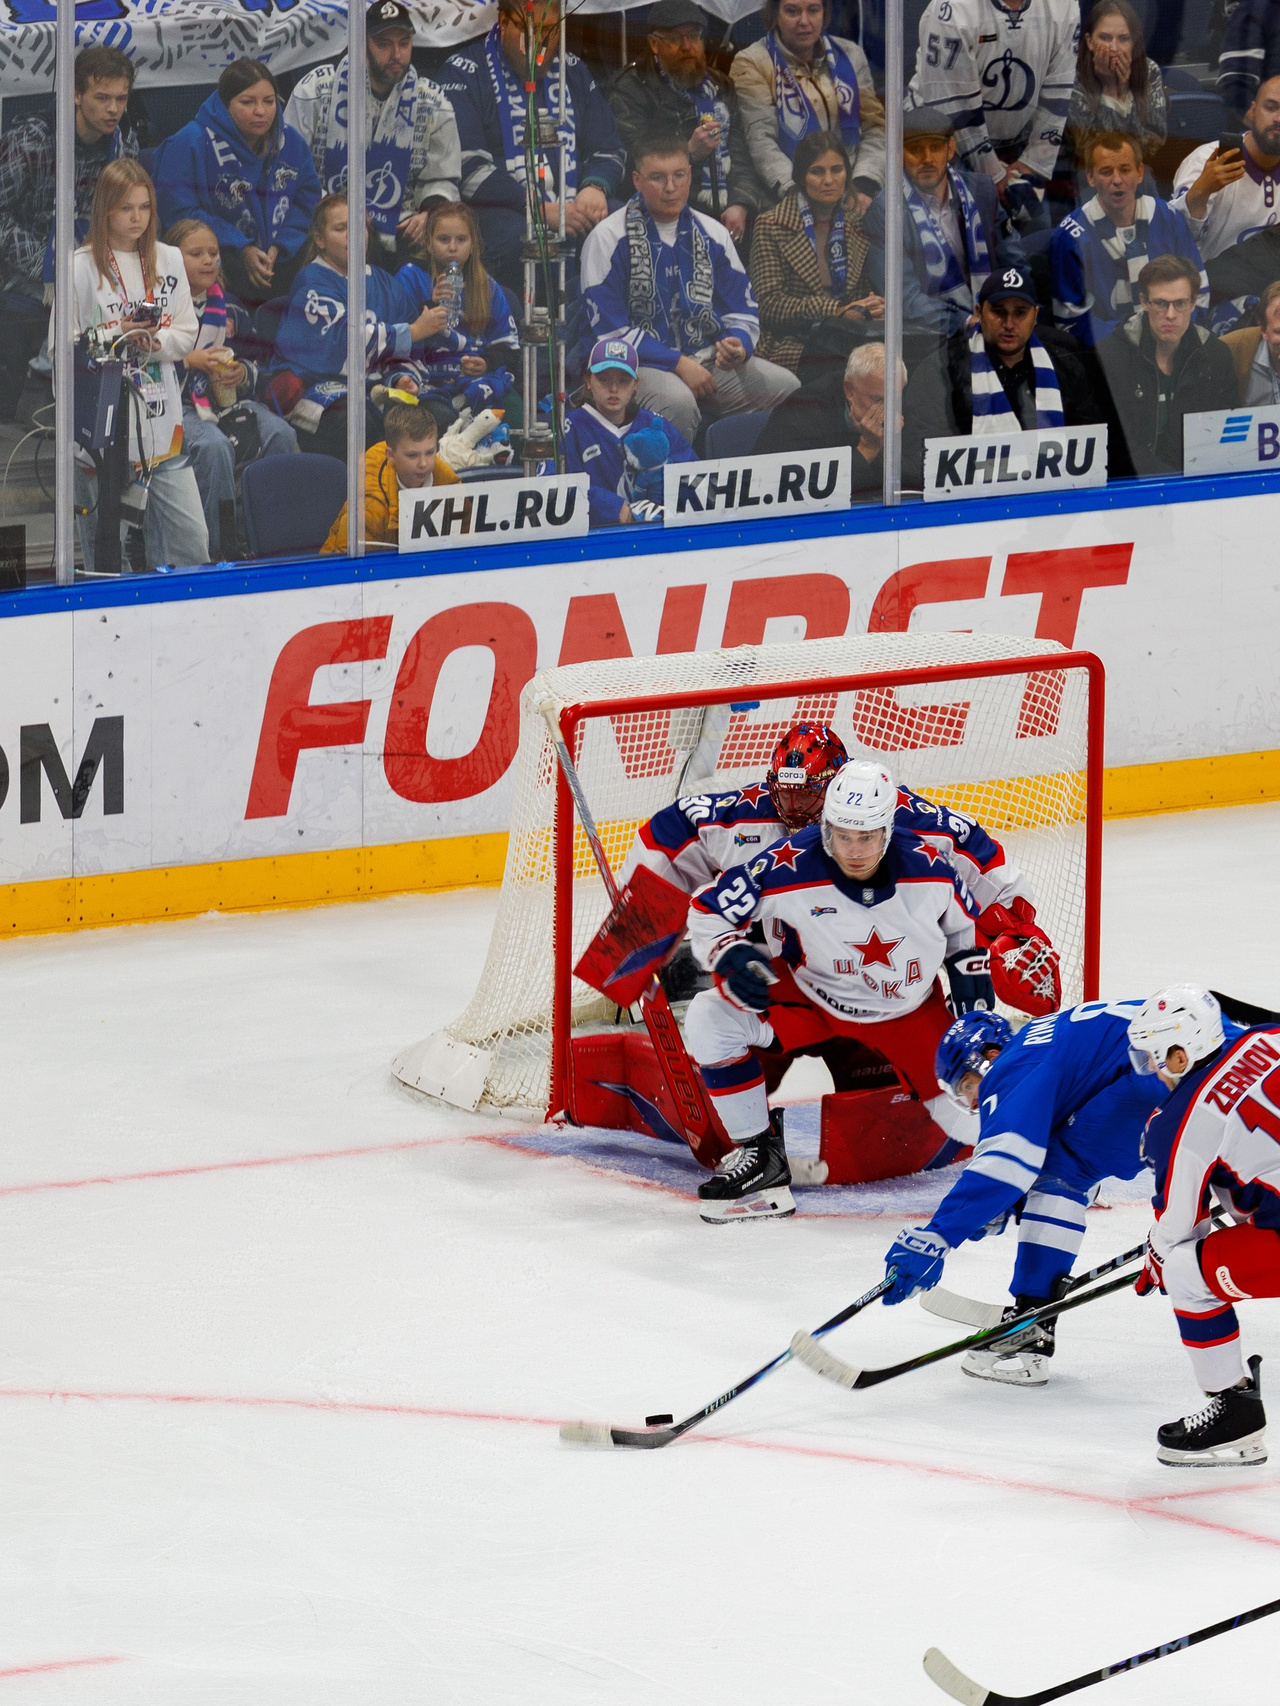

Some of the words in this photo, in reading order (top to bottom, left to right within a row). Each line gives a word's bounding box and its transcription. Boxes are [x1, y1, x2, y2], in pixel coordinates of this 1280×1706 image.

[925, 33, 962, 70] 57
[677, 459, 839, 513] KHL.RU
[935, 437, 1096, 488] KHL.RU
[411, 486, 577, 540] KHL.RU
[244, 542, 1134, 819] FONBET
[0, 715, 125, 825] M
[779, 771, 804, 779] согаз
[846, 791, 863, 806] 22
[717, 876, 756, 925] 22
[649, 1009, 704, 1124] BAUER
